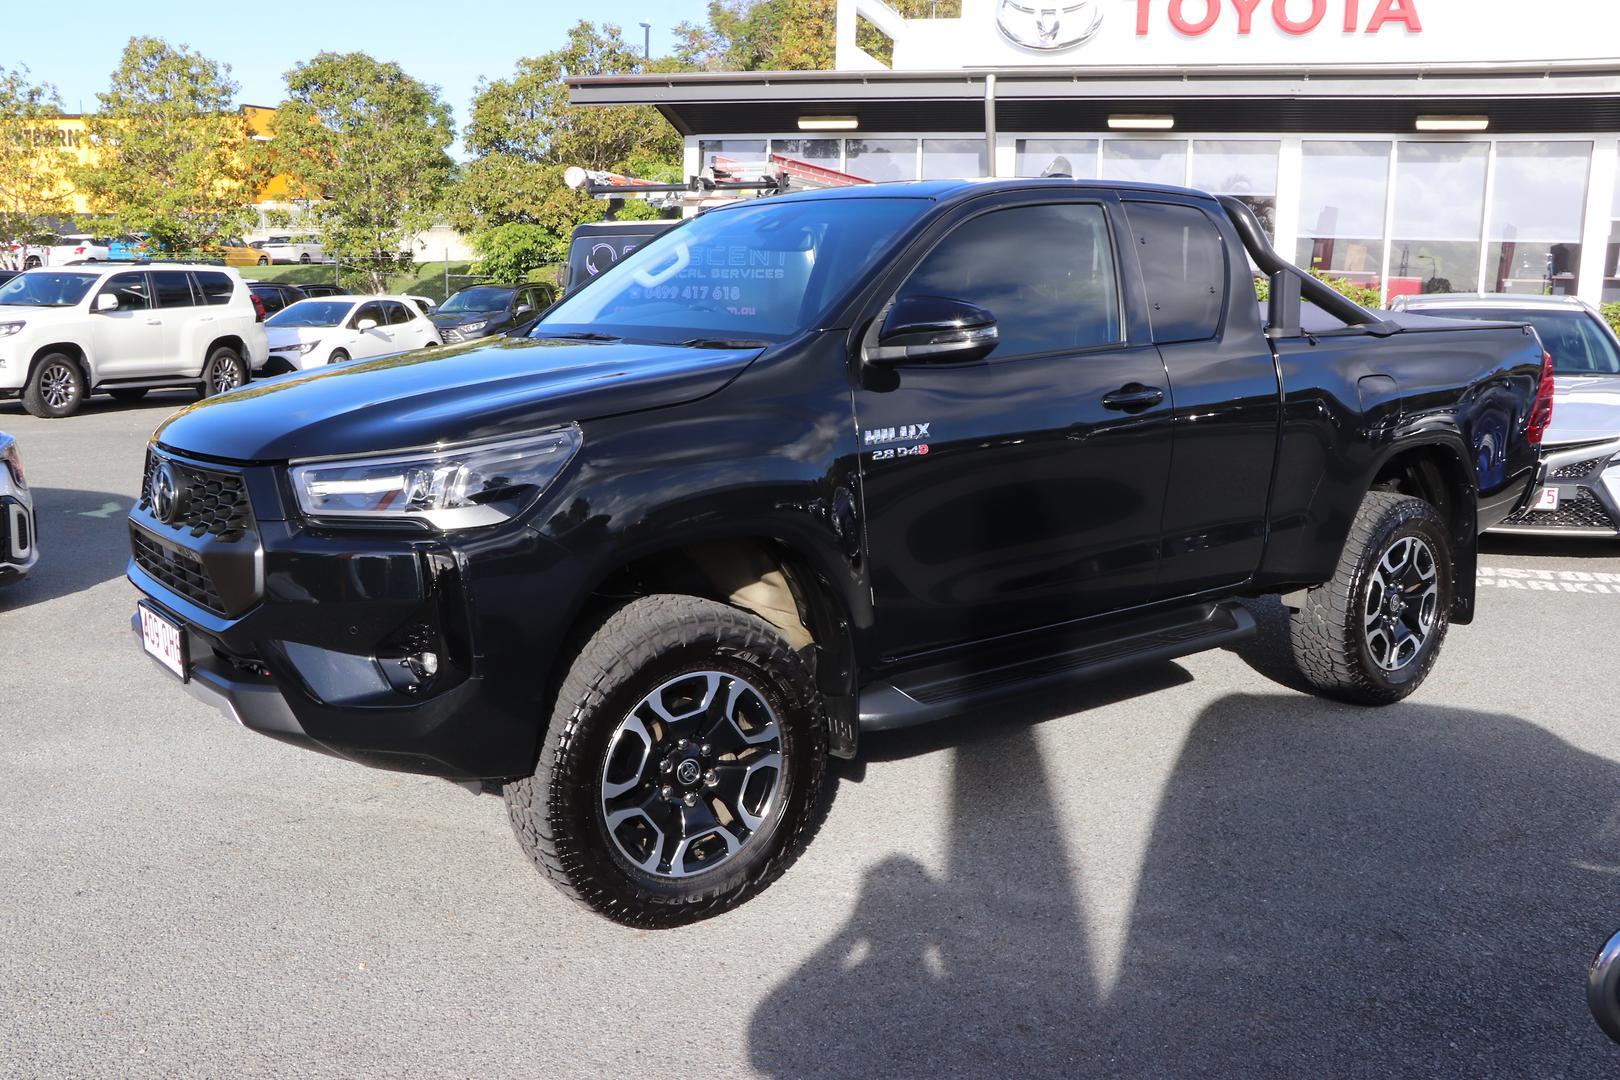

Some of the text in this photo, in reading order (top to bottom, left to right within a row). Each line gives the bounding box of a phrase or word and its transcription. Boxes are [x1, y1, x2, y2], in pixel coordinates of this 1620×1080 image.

[711, 268, 785, 279] SERVICES
[682, 285, 709, 299] 417
[864, 422, 930, 446] HILUX
